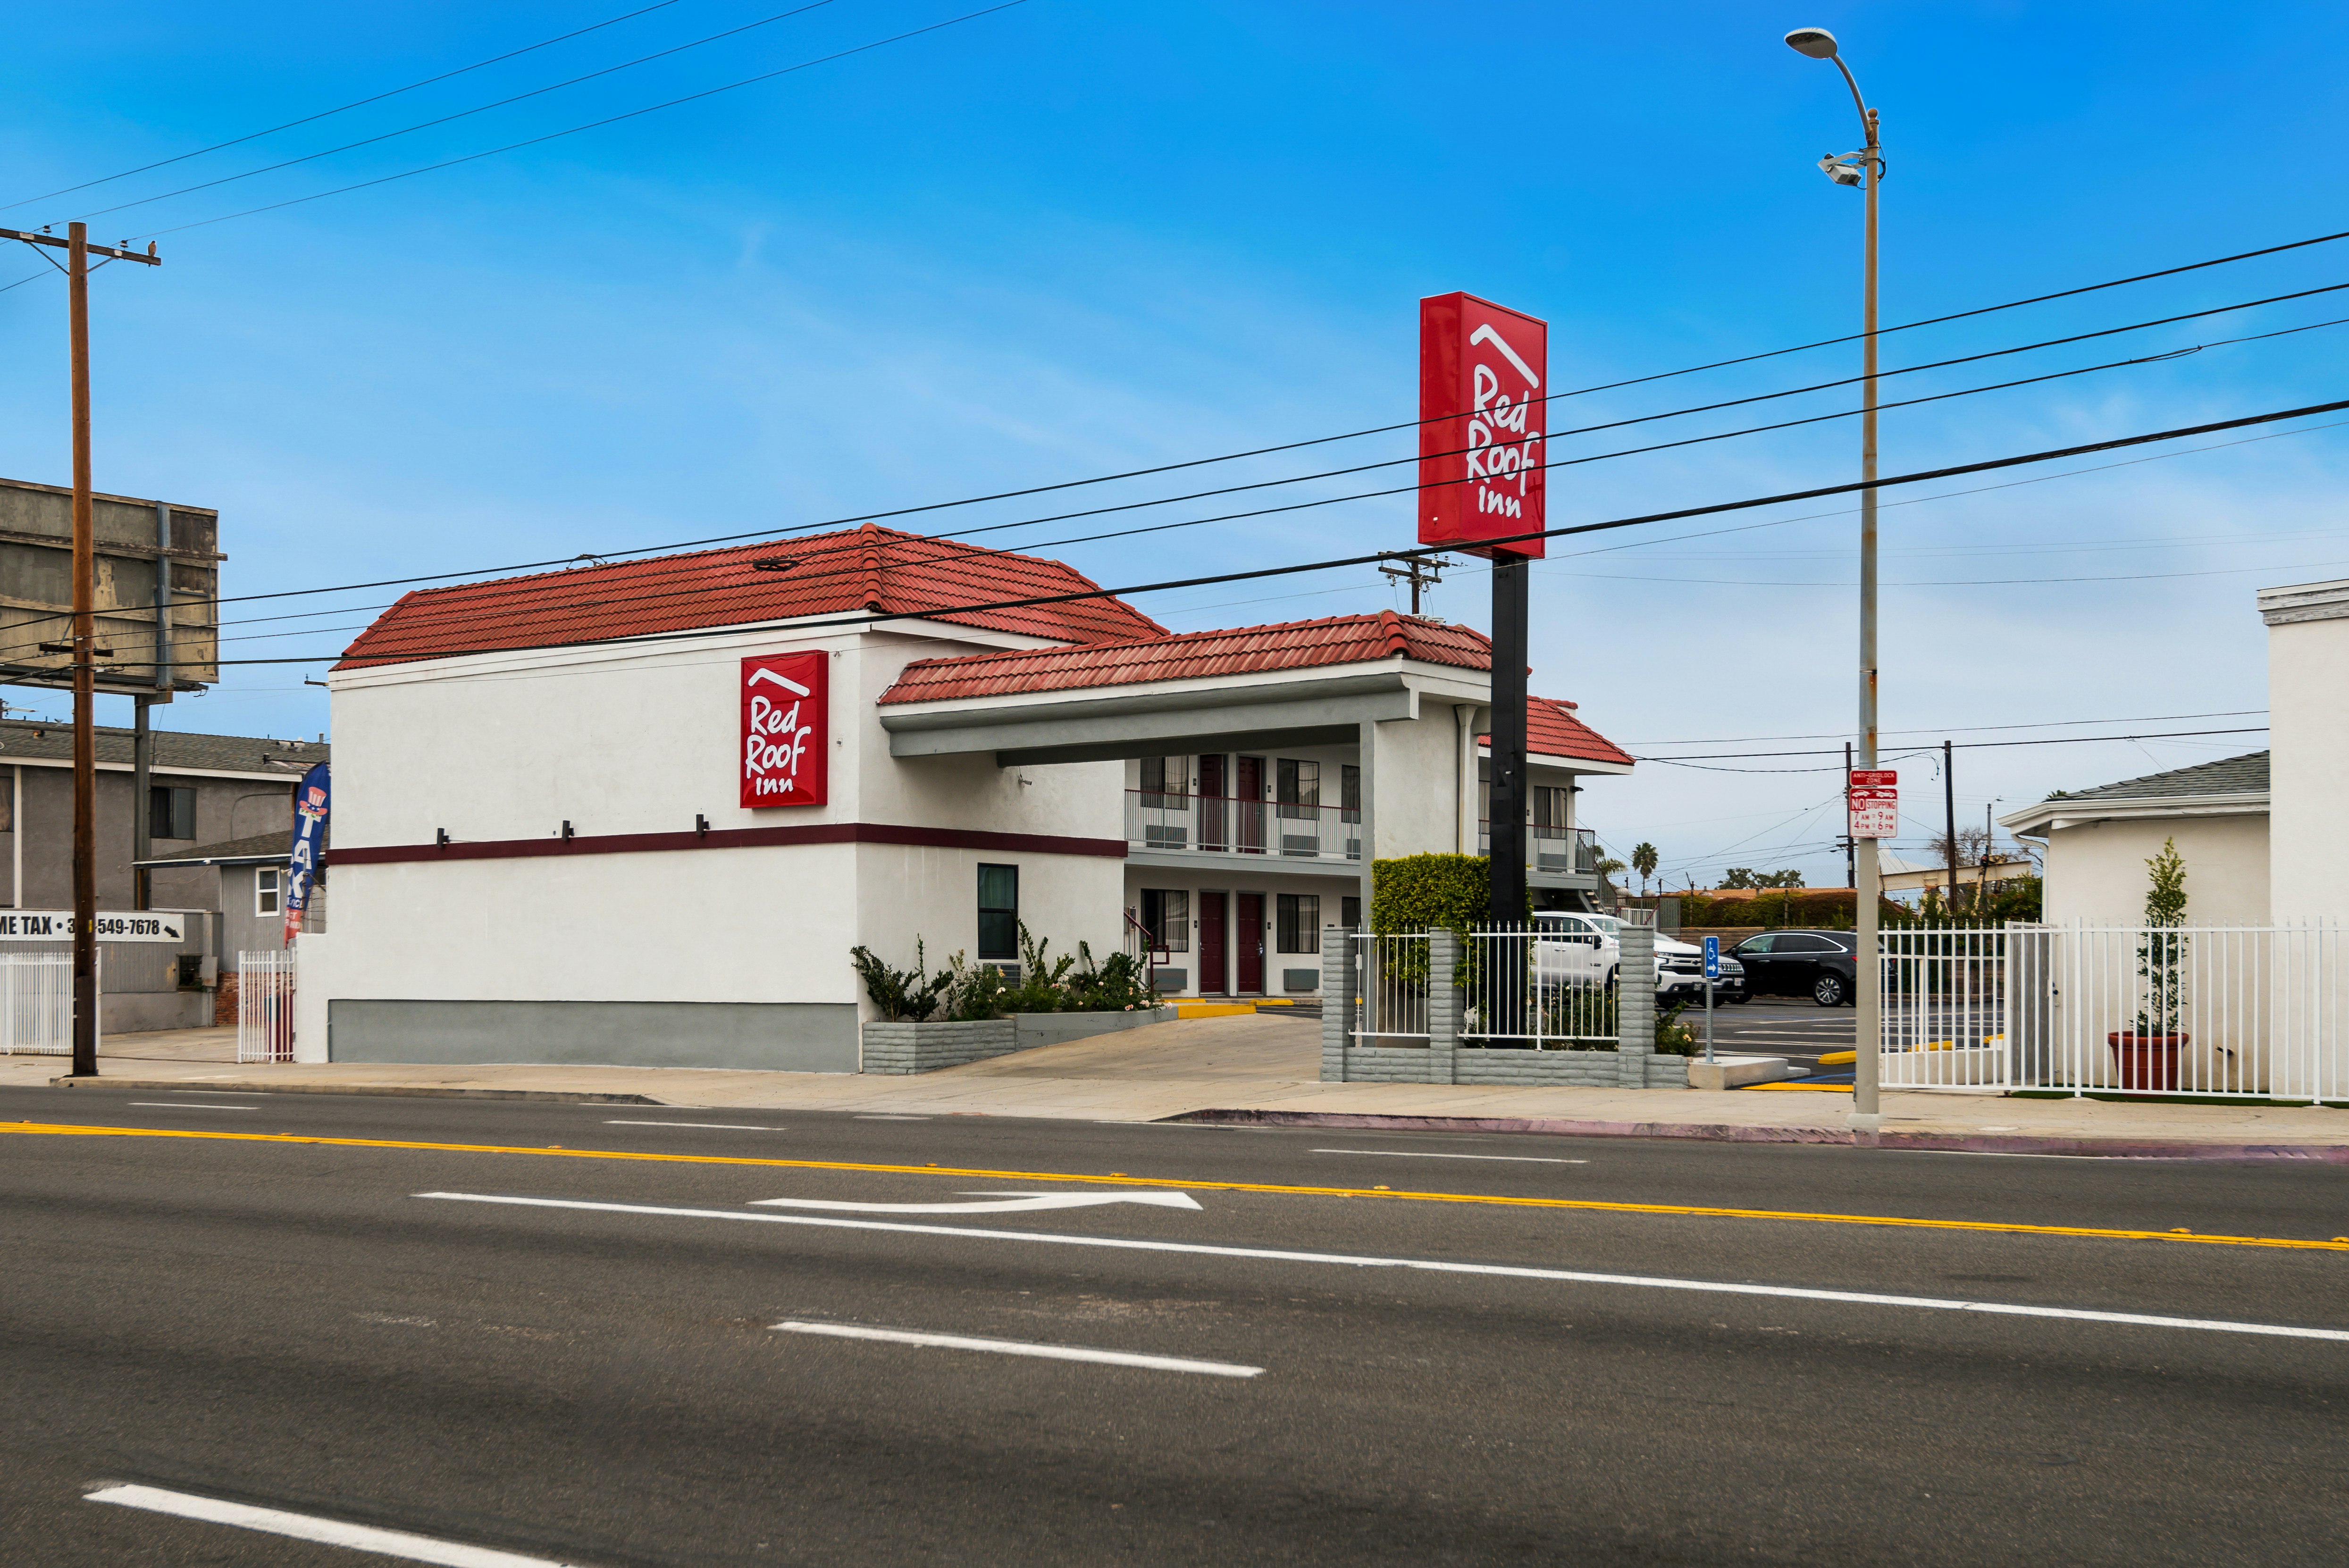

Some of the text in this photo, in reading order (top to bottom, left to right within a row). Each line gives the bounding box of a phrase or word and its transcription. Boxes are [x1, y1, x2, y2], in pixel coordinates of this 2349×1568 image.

[1474, 363, 1529, 434] Red
[1466, 419, 1540, 497] Roof
[751, 695, 800, 736] Red
[745, 725, 812, 779] Roof
[1851, 798, 1895, 810] NO STOPPING
[1854, 812, 1859, 820] 7
[1878, 812, 1883, 820] 9
[1854, 821, 1859, 829] 4
[1878, 821, 1883, 830] 6
[21, 916, 53, 935] TAX
[67, 918, 160, 935] 3-549-7678
